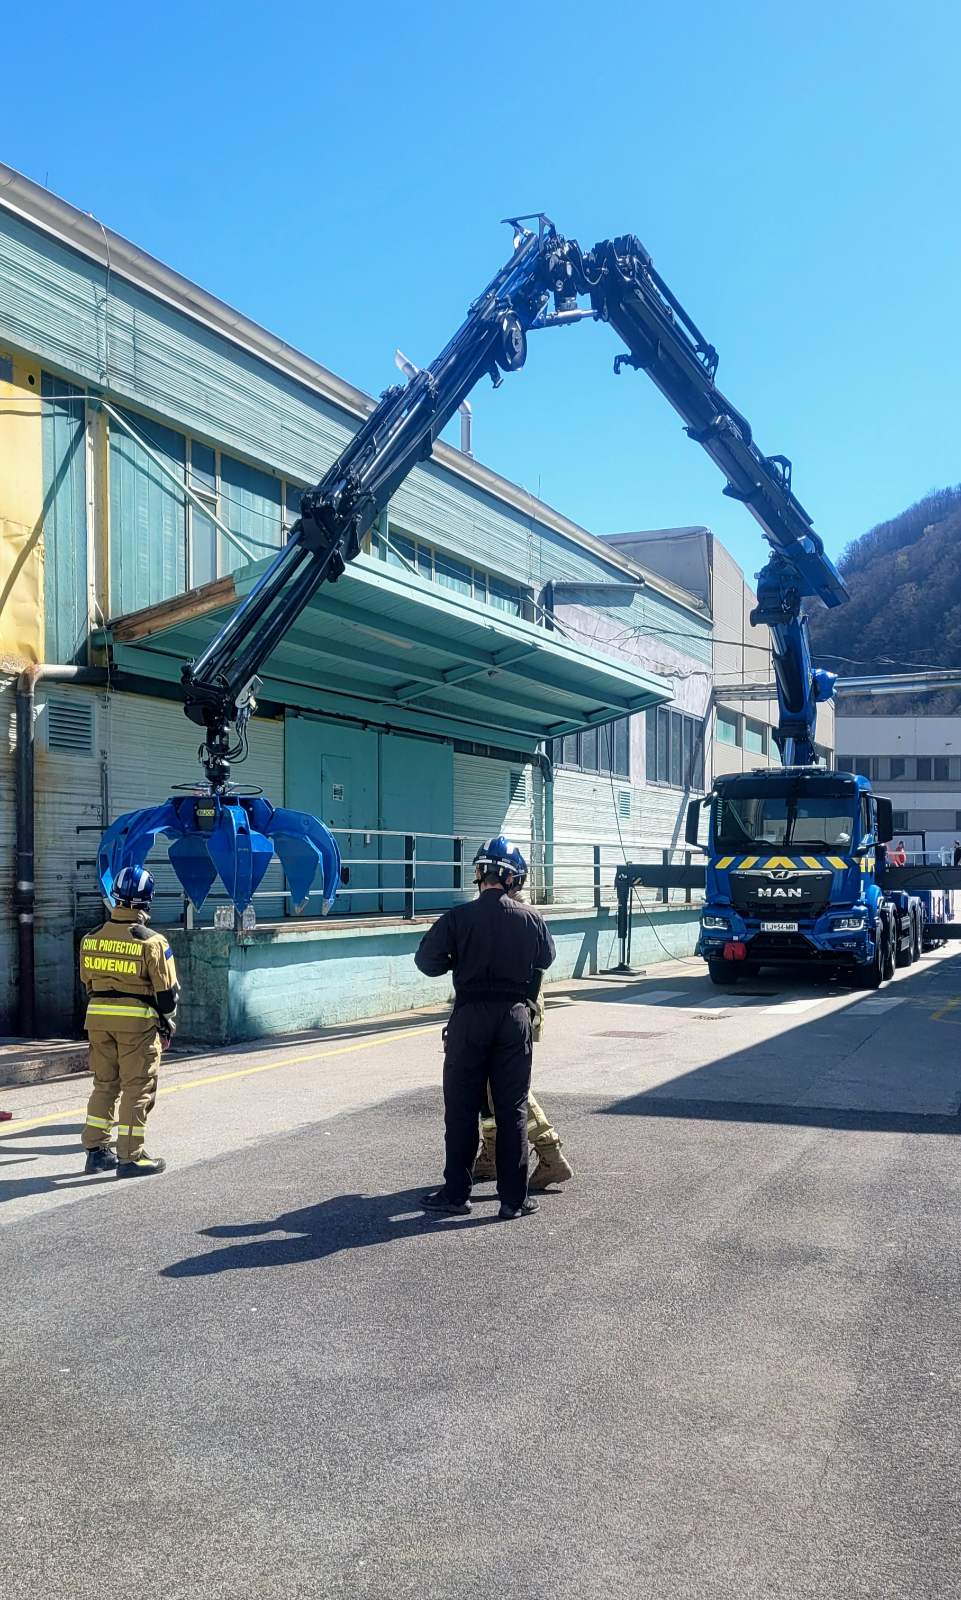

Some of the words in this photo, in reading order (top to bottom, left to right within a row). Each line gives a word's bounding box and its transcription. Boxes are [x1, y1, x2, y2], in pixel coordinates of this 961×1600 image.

[758, 888, 801, 897] MAN
[83, 938, 97, 950] CIVIL
[98, 940, 143, 955] PROTECTION
[84, 956, 137, 974] SLOVENIA
